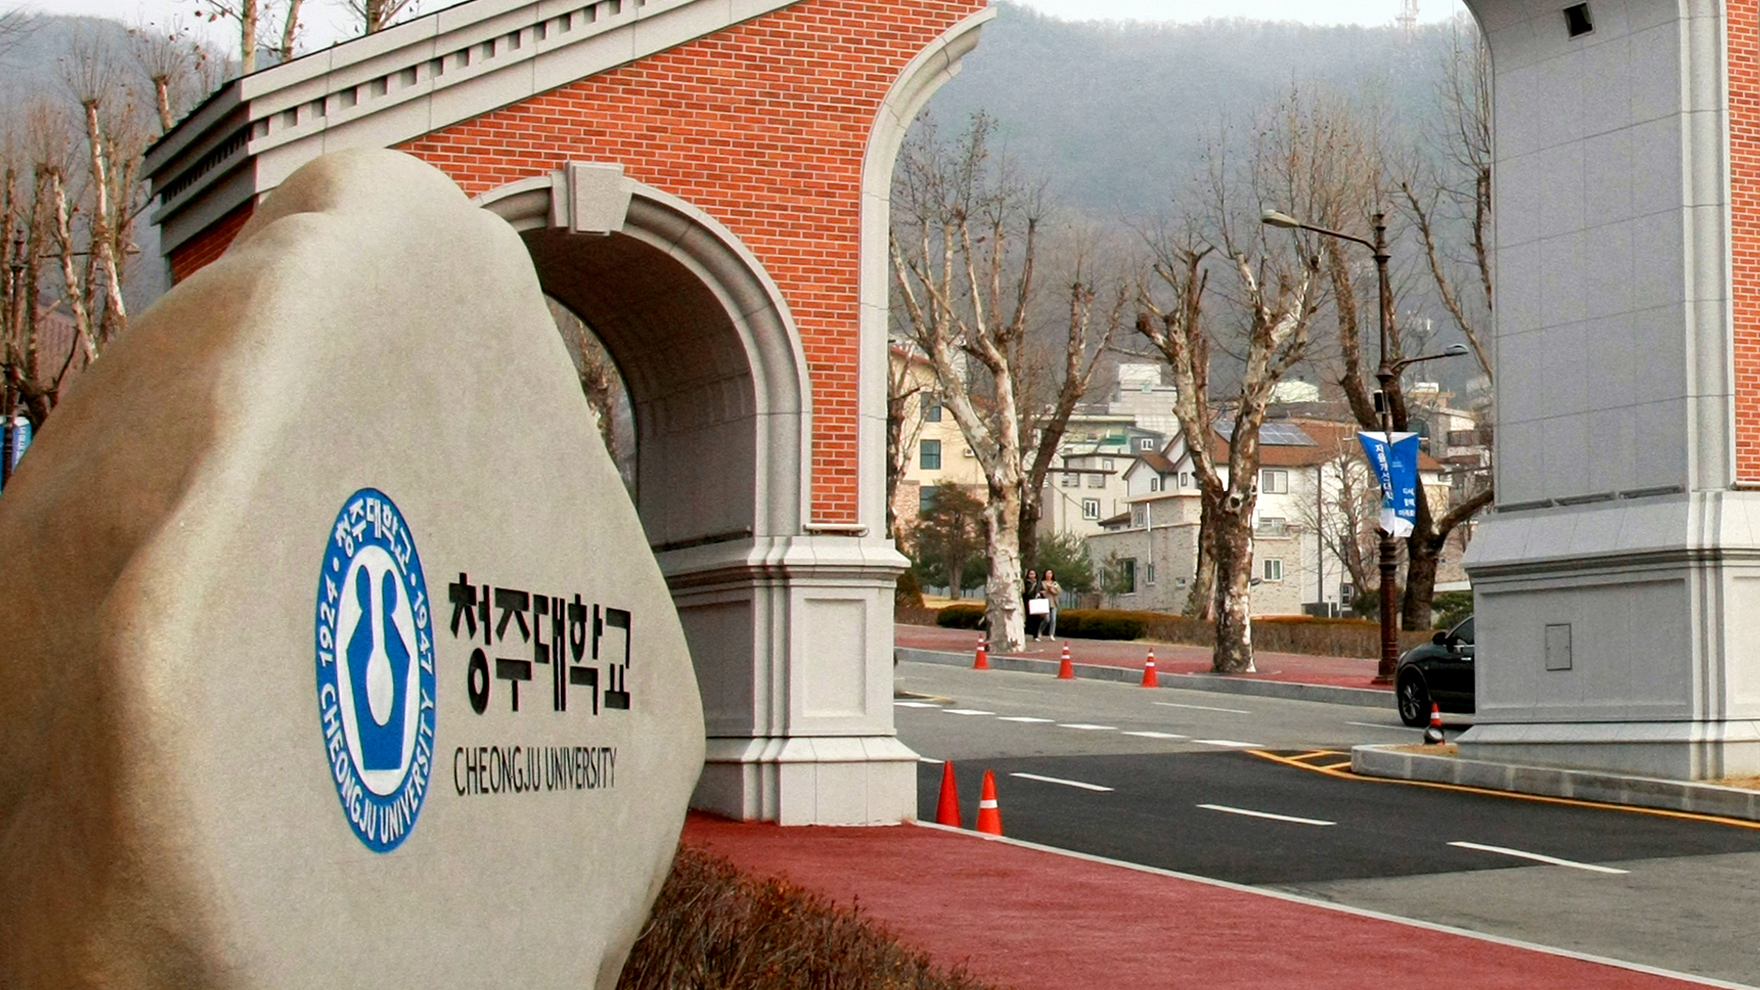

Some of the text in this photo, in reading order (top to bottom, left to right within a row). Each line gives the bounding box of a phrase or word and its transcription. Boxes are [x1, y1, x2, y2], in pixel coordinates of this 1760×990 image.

[335, 498, 412, 575] 청주대학교
[319, 573, 338, 666] 1924
[411, 589, 433, 675] 1947
[449, 572, 631, 715] 청주대학교
[320, 682, 435, 844] CHEONGJU UNIVERSITY
[454, 746, 618, 796] CHEONGJU UNIVERSITY
